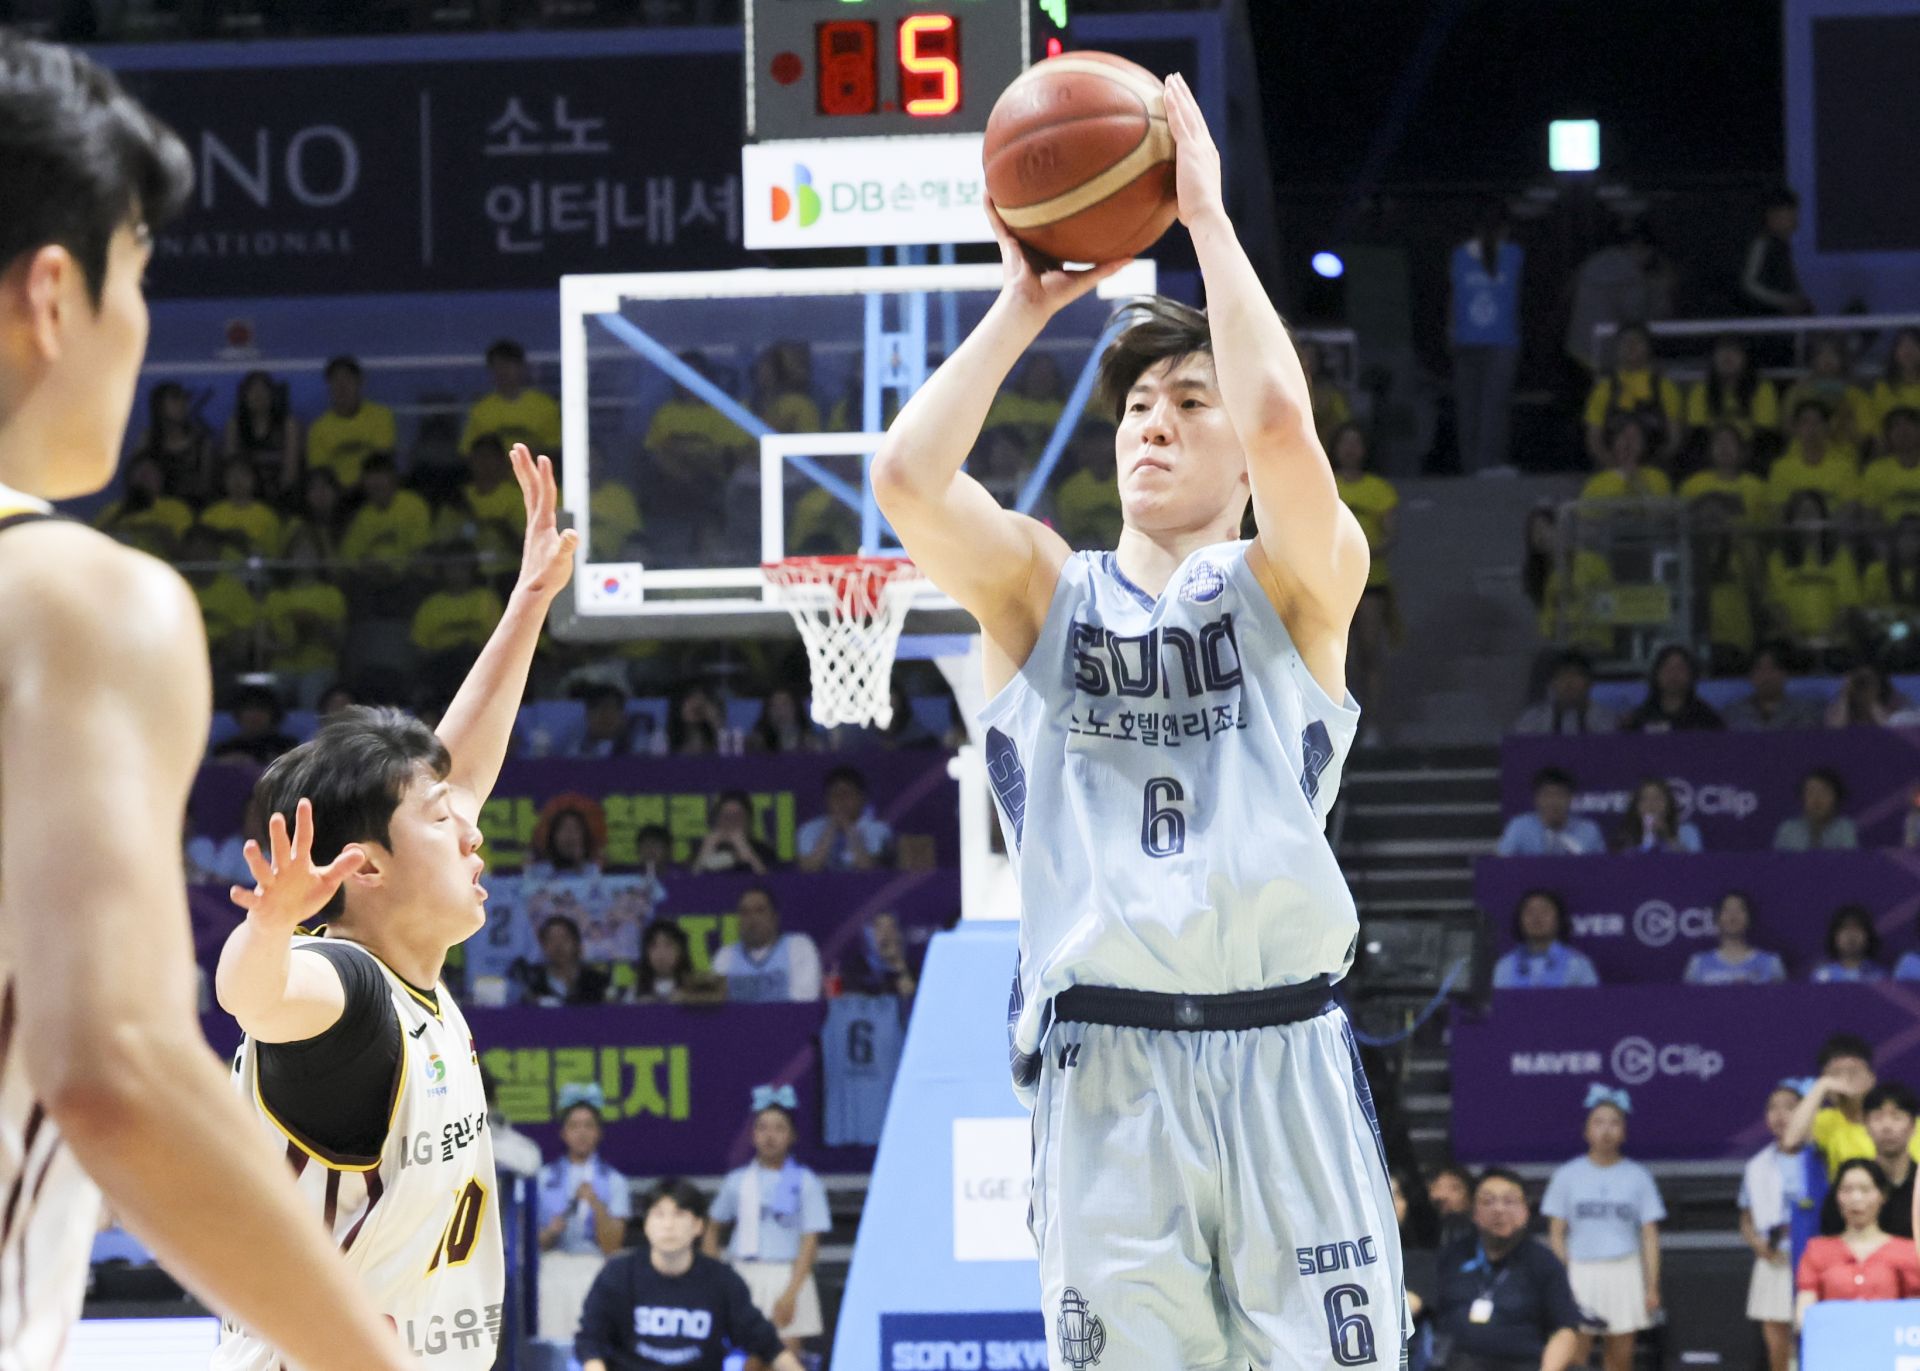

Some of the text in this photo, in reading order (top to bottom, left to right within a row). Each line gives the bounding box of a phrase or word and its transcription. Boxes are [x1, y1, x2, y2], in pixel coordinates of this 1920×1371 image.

[900, 14, 959, 116] 5
[484, 97, 610, 154] 소노
[201, 124, 361, 207] NO
[484, 174, 742, 252] 인터내셔
[832, 182, 983, 213] DB손해보
[156, 230, 352, 256] NATIONAL
[1140, 776, 1186, 858] 6
[1698, 782, 1758, 821] Clip
[1572, 912, 1625, 937] VER
[848, 1020, 873, 1065] 6
[1511, 1044, 1724, 1081] NAVER Clip
[484, 1045, 690, 1124] 챌린지
[400, 1131, 433, 1170] LG
[1323, 1283, 1378, 1367] 6
